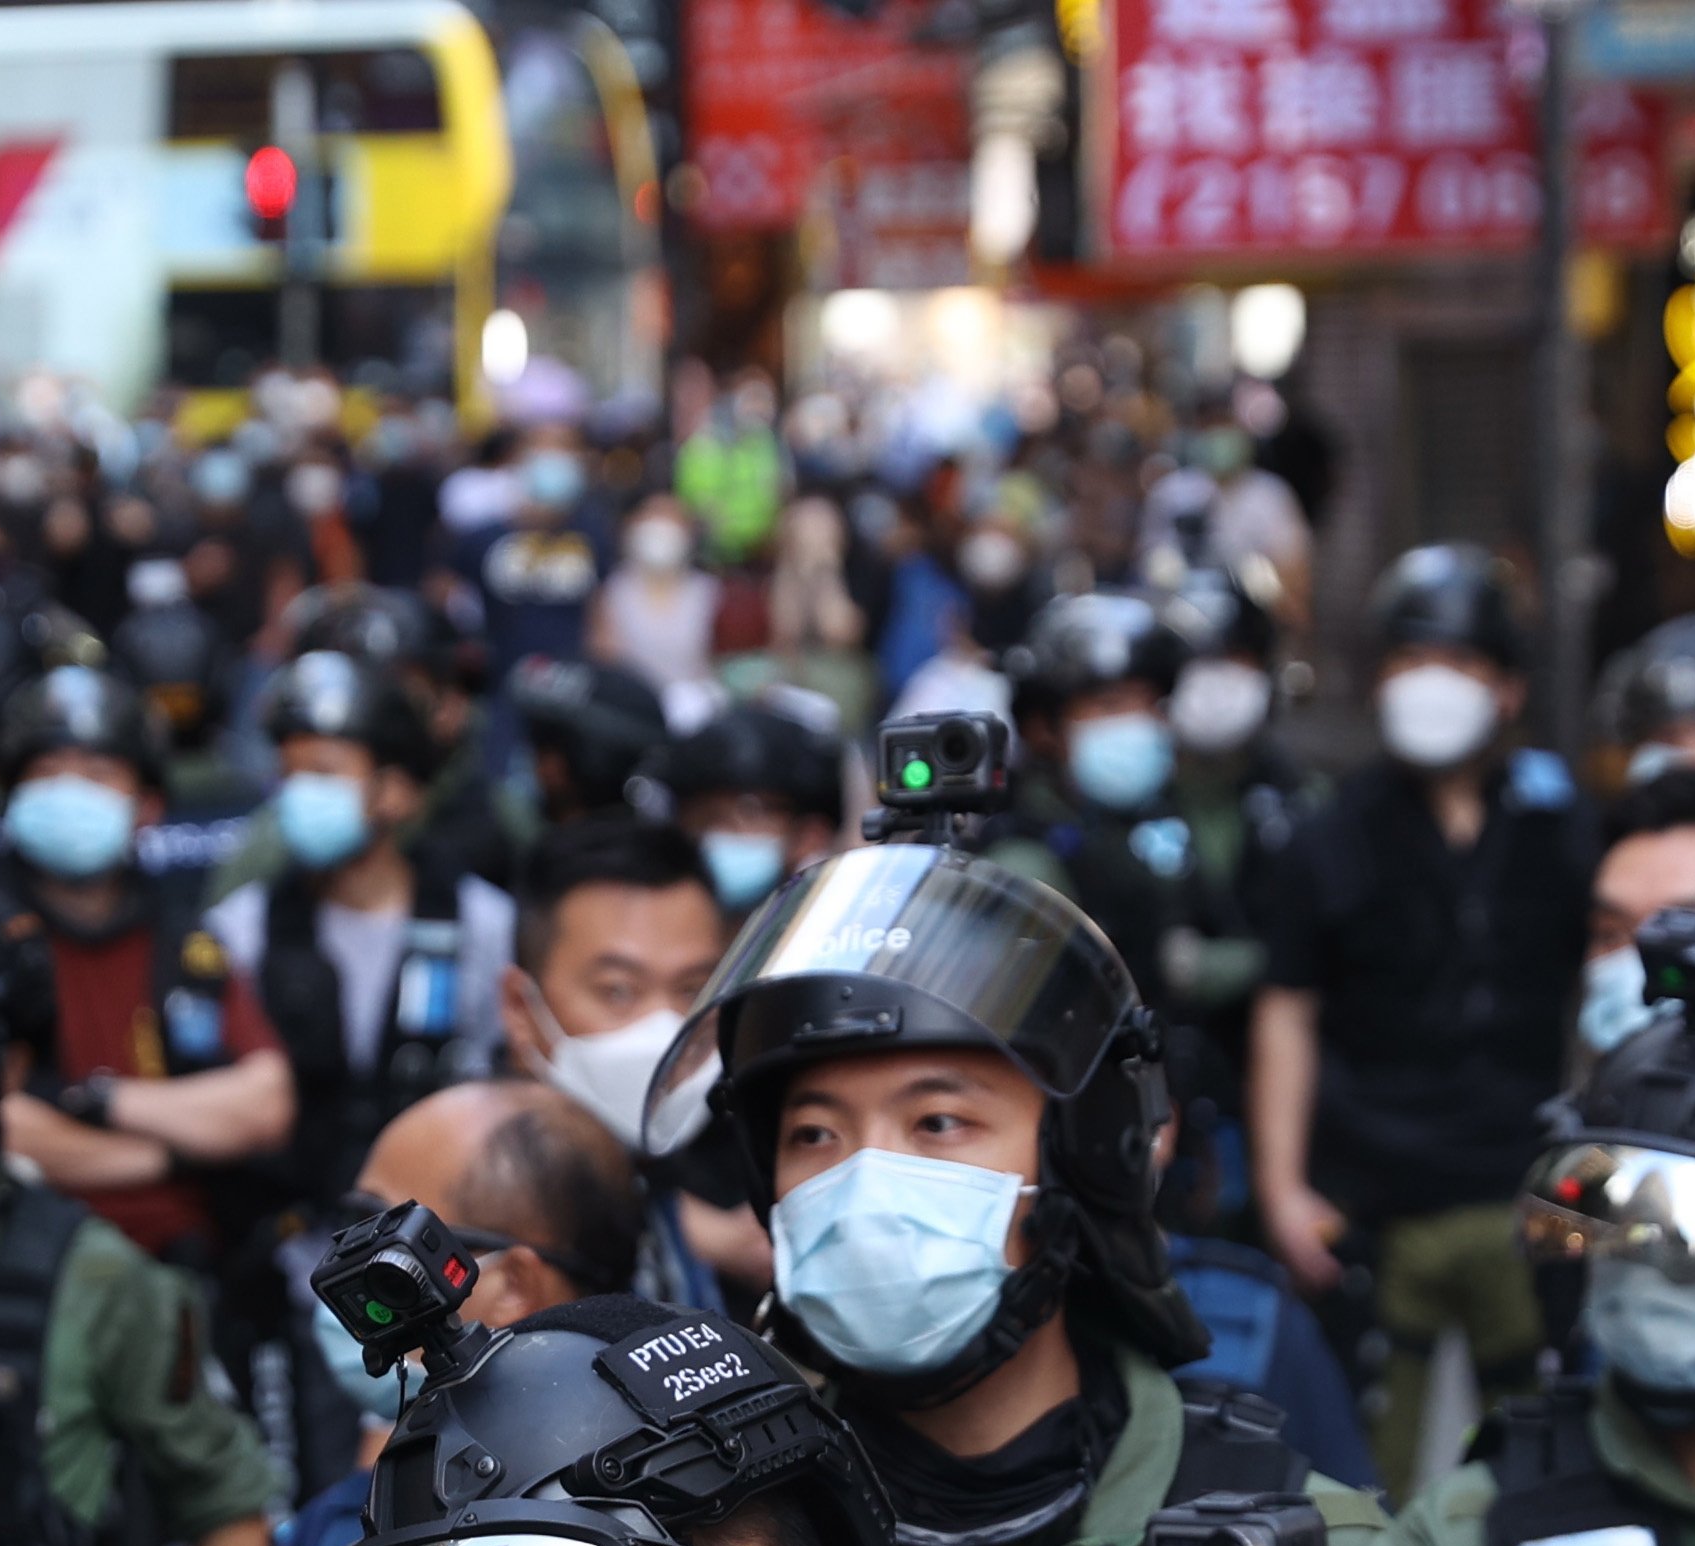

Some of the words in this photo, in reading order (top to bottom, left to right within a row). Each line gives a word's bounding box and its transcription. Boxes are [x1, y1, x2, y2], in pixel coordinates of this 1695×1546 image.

[628, 1333, 686, 1371] PTU
[679, 1323, 723, 1349] E4
[663, 1352, 750, 1401] 2Sec2
